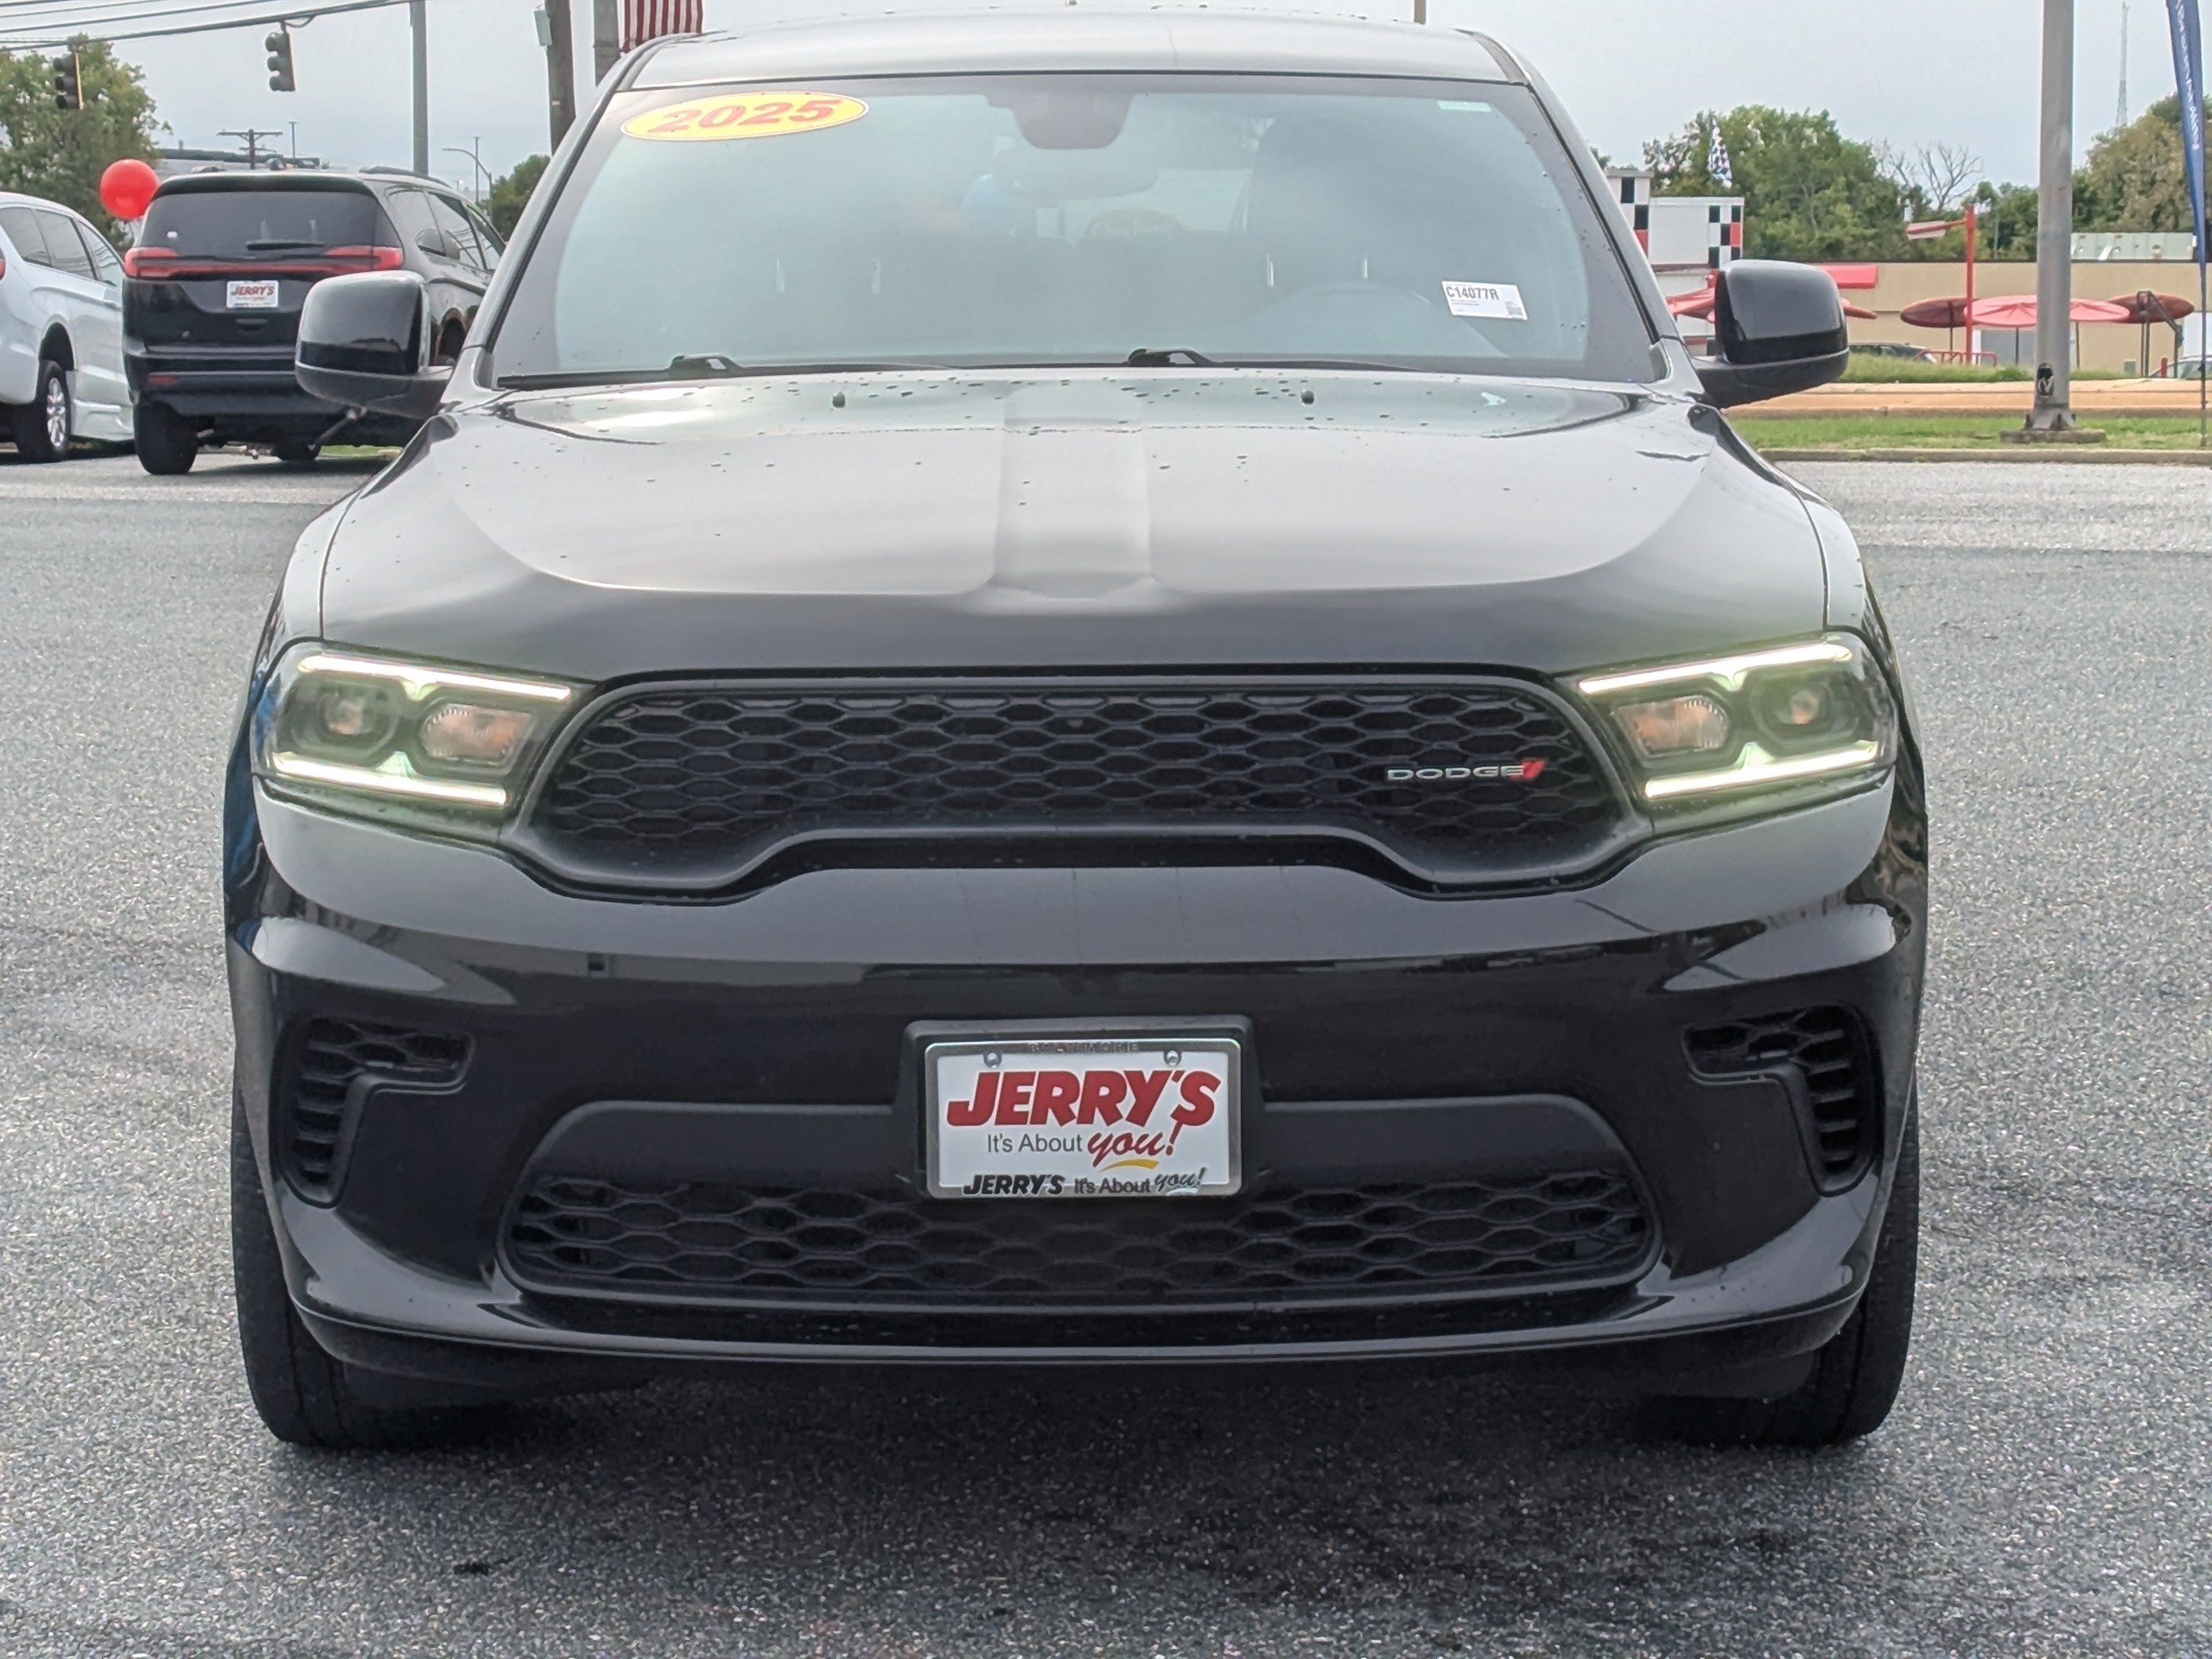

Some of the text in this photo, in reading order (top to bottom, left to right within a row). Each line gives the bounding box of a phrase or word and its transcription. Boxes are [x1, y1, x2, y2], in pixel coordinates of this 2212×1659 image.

[647, 99, 844, 133] 2025
[1446, 286, 1500, 301] C14077R
[1388, 765, 1524, 781] DODGE
[946, 1070, 1222, 1128] JERRY'S
[988, 1127, 1184, 1168] It's About you!
[963, 1173, 1066, 1195] JERRY'S
[1074, 1166, 1207, 1194] It's About you!
